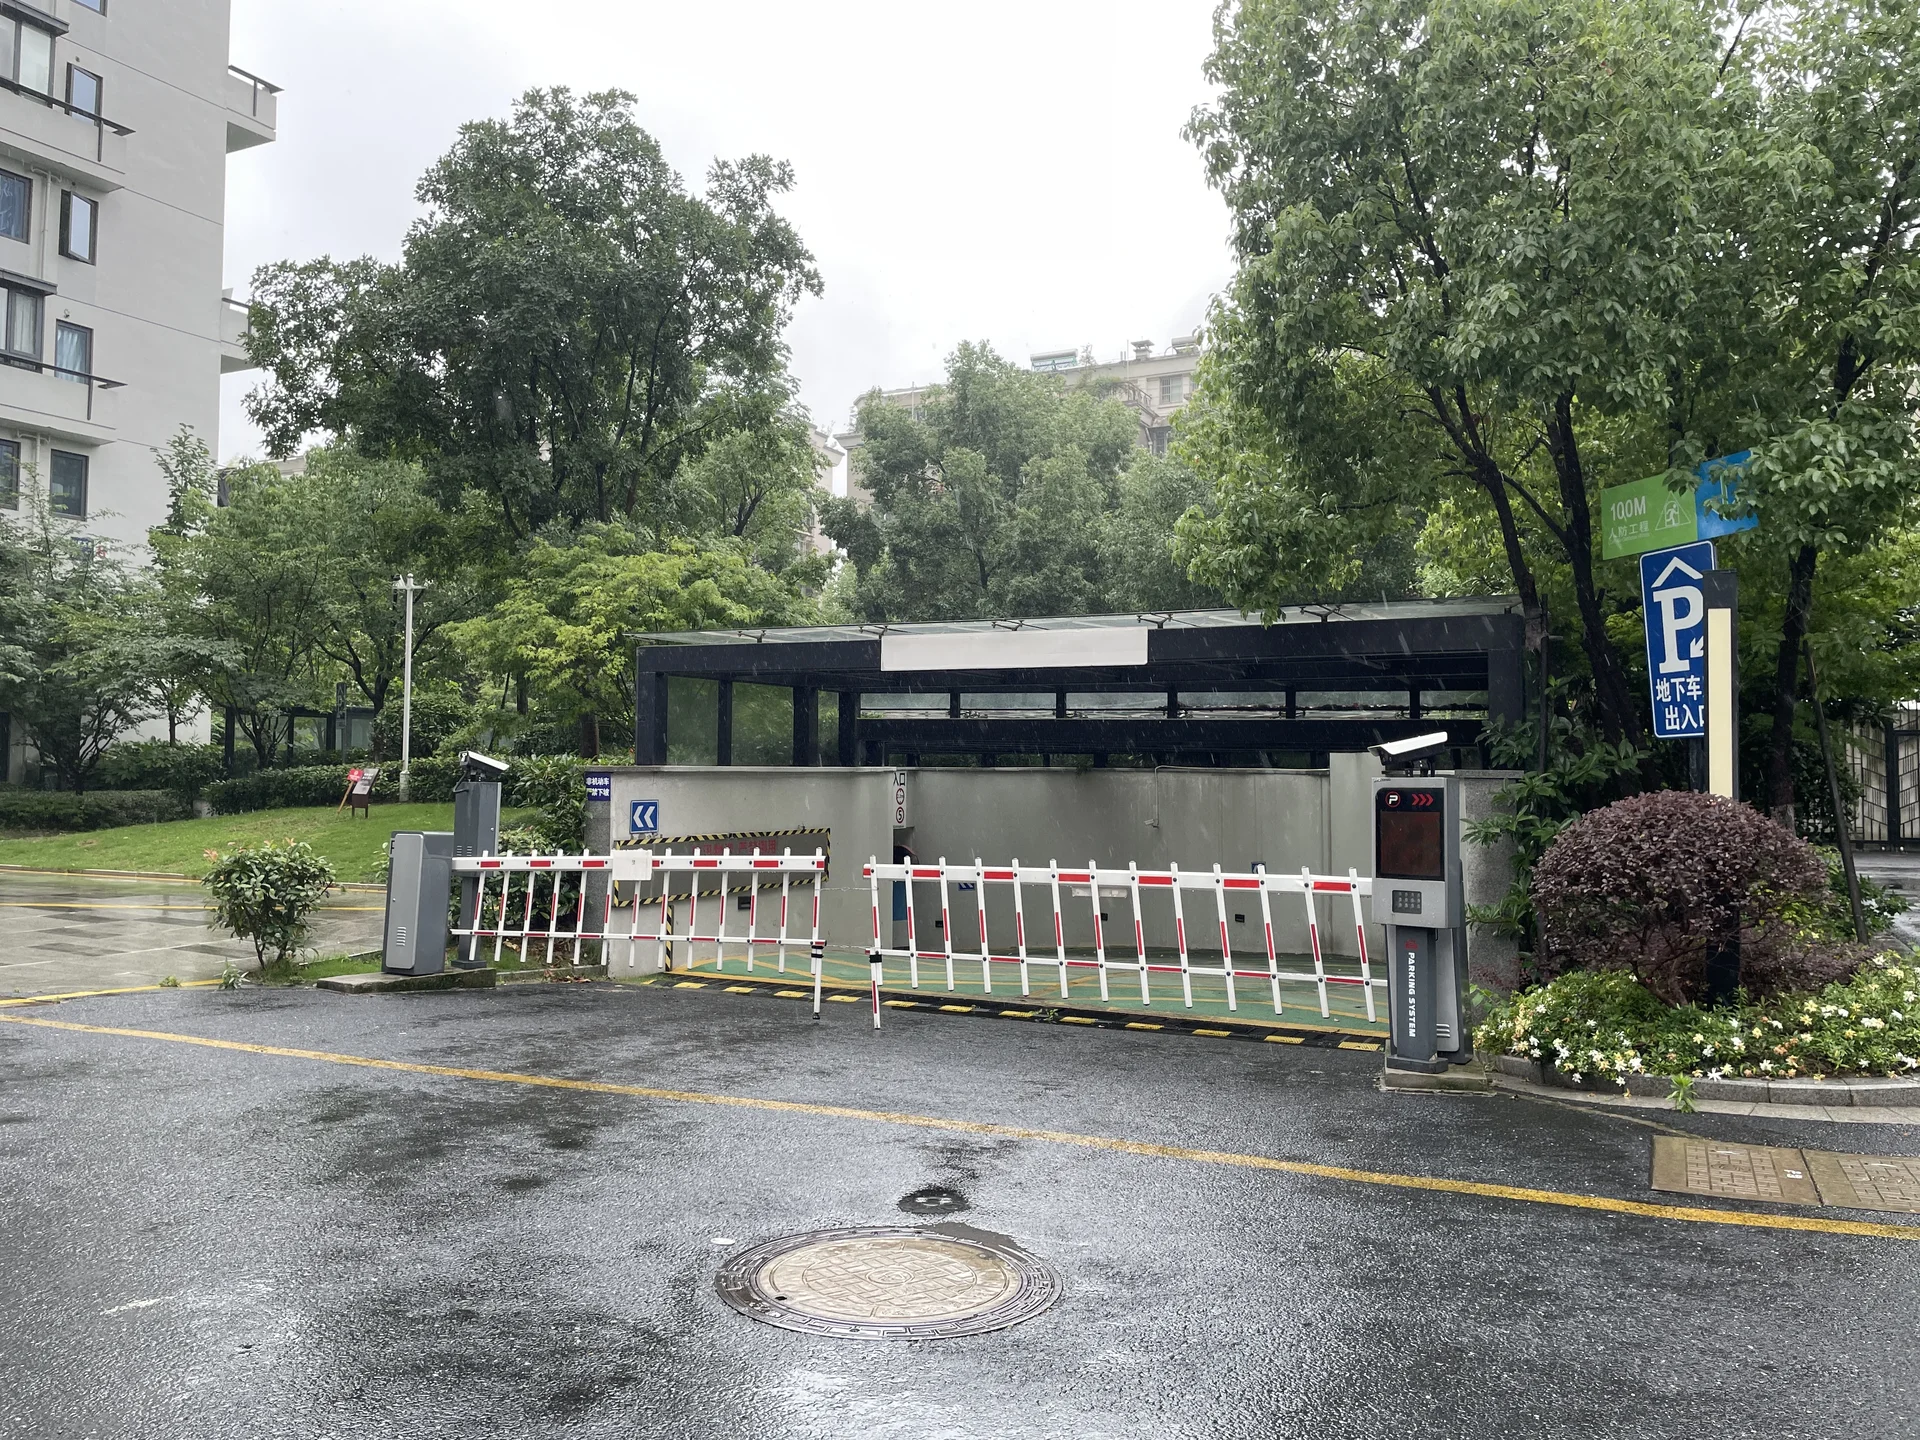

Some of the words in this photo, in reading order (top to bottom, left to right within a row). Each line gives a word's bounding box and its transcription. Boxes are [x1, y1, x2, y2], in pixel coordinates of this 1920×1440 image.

[1611, 496, 1646, 520] 100M
[1609, 521, 1649, 538] 人防工程
[1653, 585, 1704, 674] P
[1656, 675, 1704, 702] 地下车
[893, 772, 905, 786] 入口
[1388, 795, 1398, 805] P
[1408, 952, 1416, 995] PARKING
[1408, 998, 1416, 1037] SYSTEM
